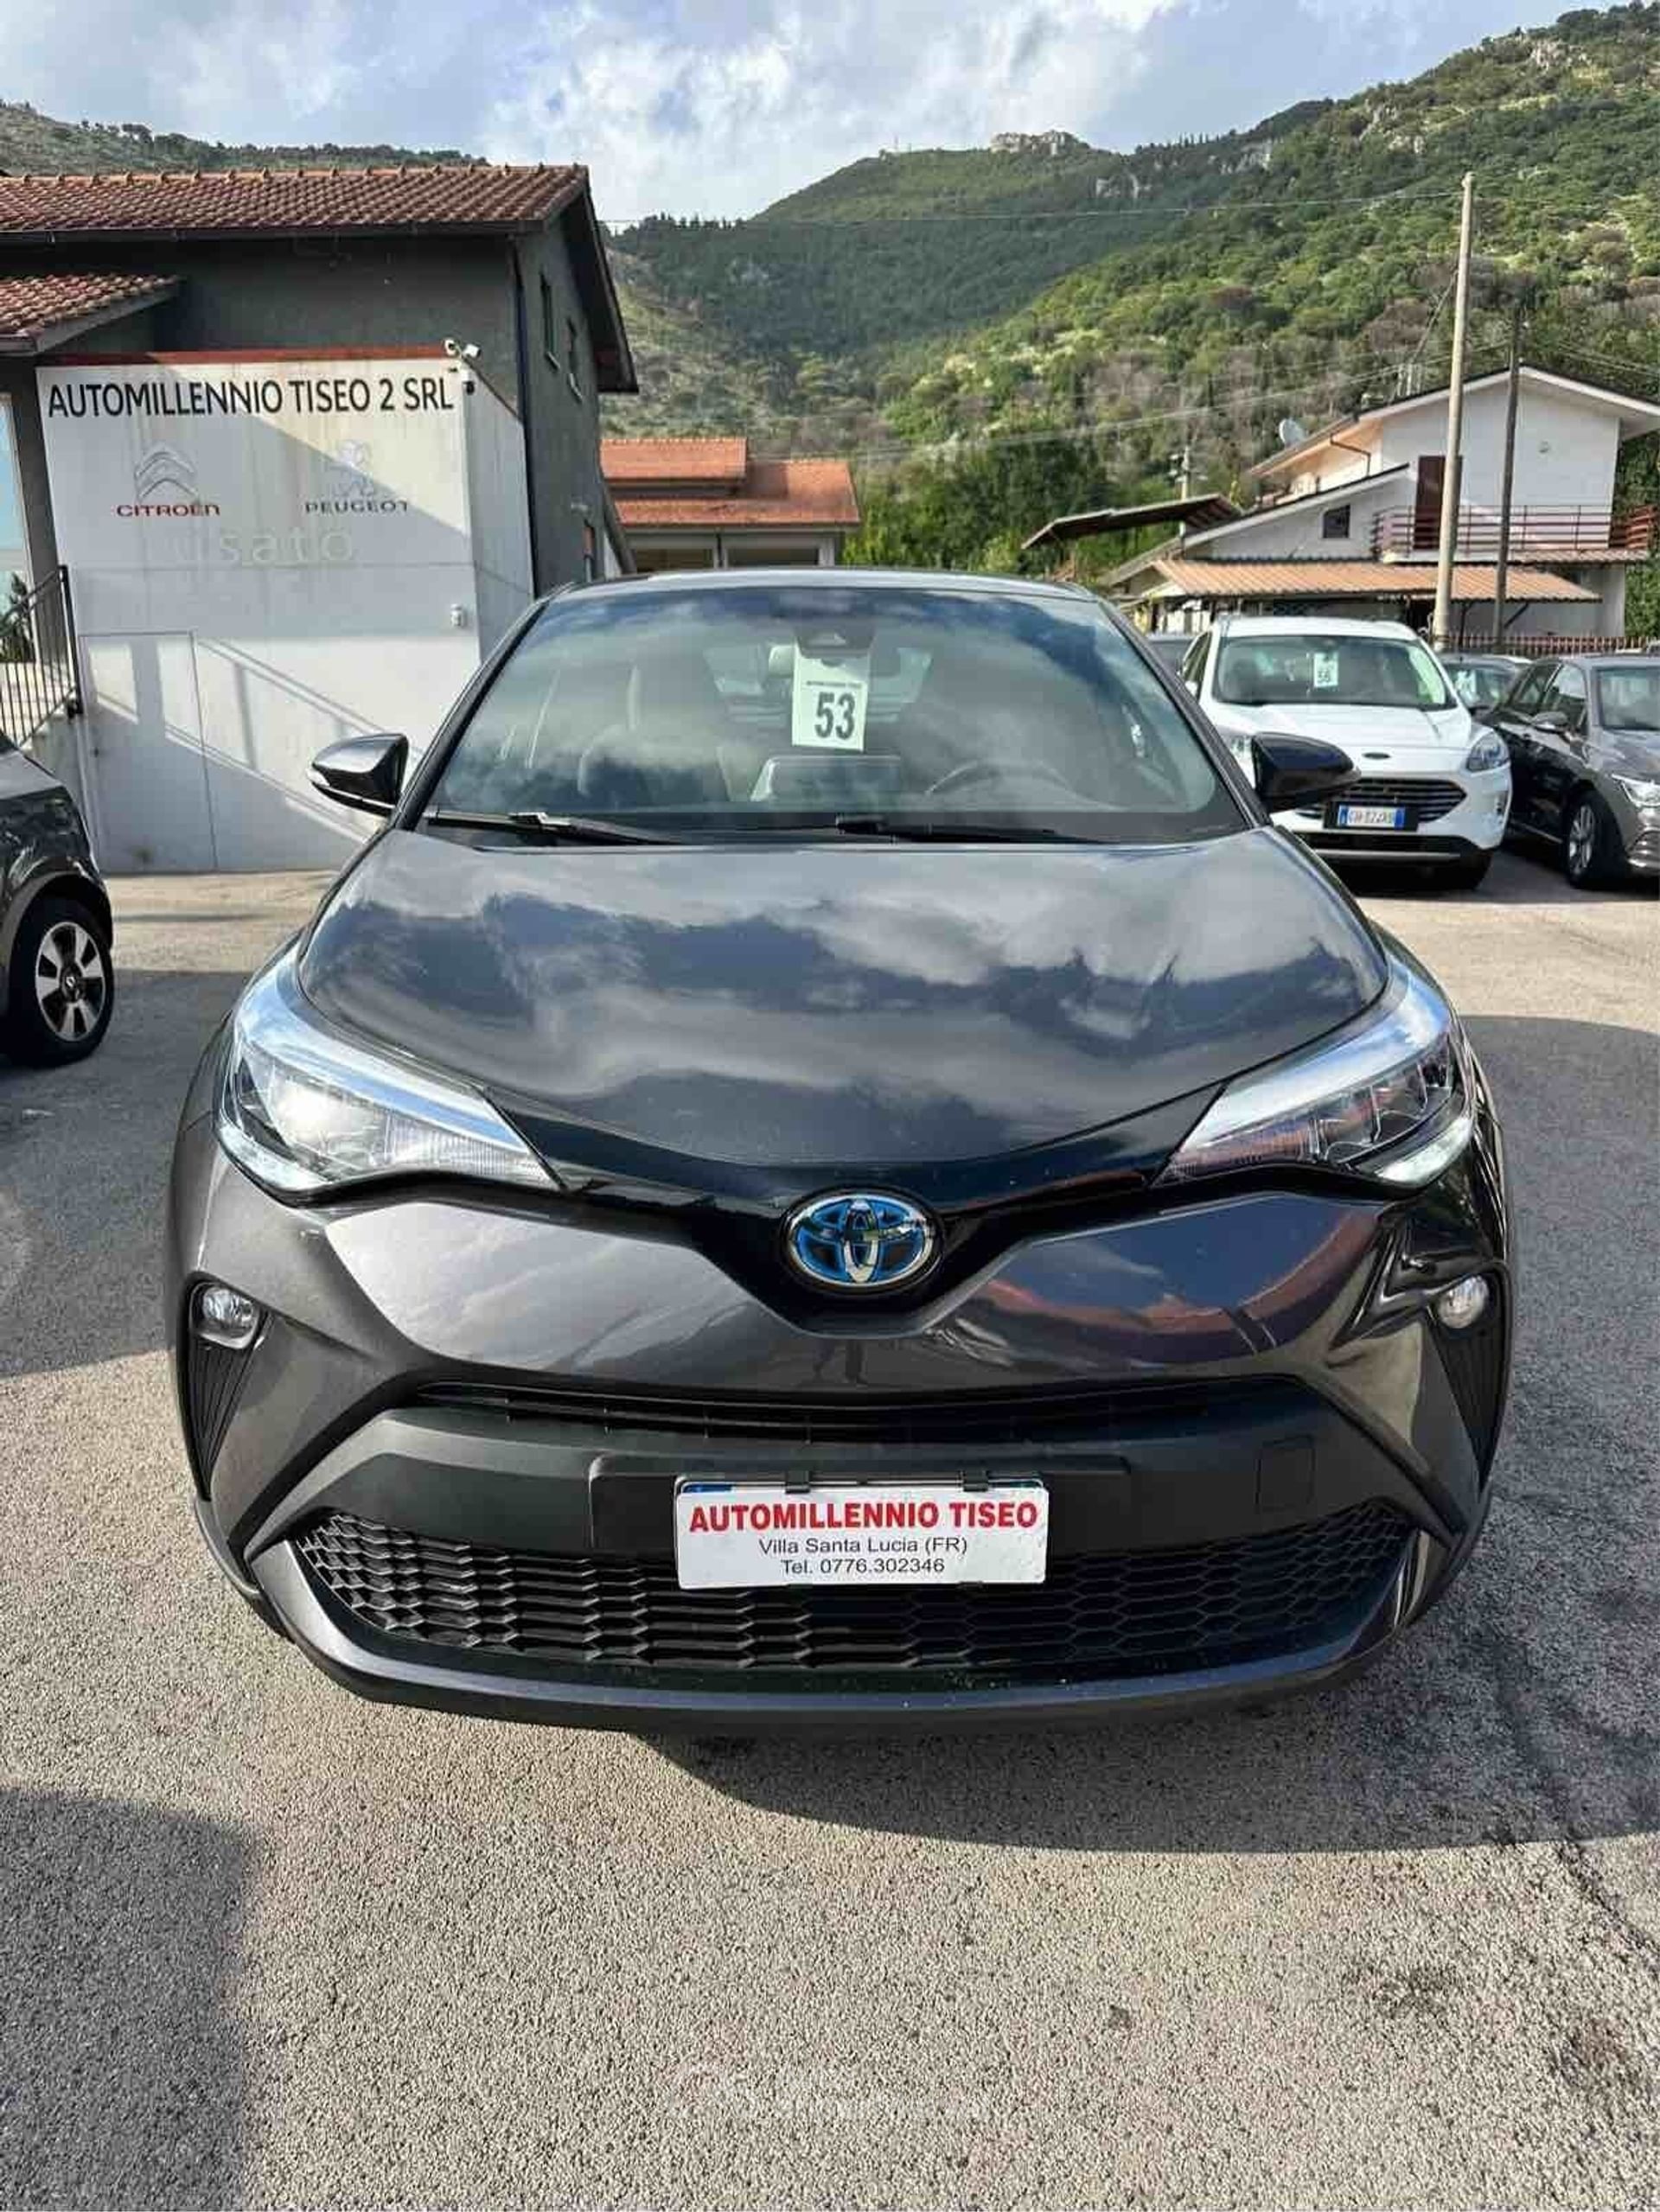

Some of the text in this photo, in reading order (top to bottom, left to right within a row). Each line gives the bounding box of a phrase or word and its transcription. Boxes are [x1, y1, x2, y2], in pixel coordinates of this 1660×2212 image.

[48, 378, 454, 418] AUTOMILLENNIO TISEO 2 SRL
[305, 500, 408, 514] PEUGEOT
[814, 692, 856, 740] 53
[689, 1501, 1038, 1533] AUTOMILLENNIO TISEO
[757, 1536, 968, 1556] Villa Santa Lucia (FR)
[780, 1558, 946, 1575] Tel. 0776.302346
